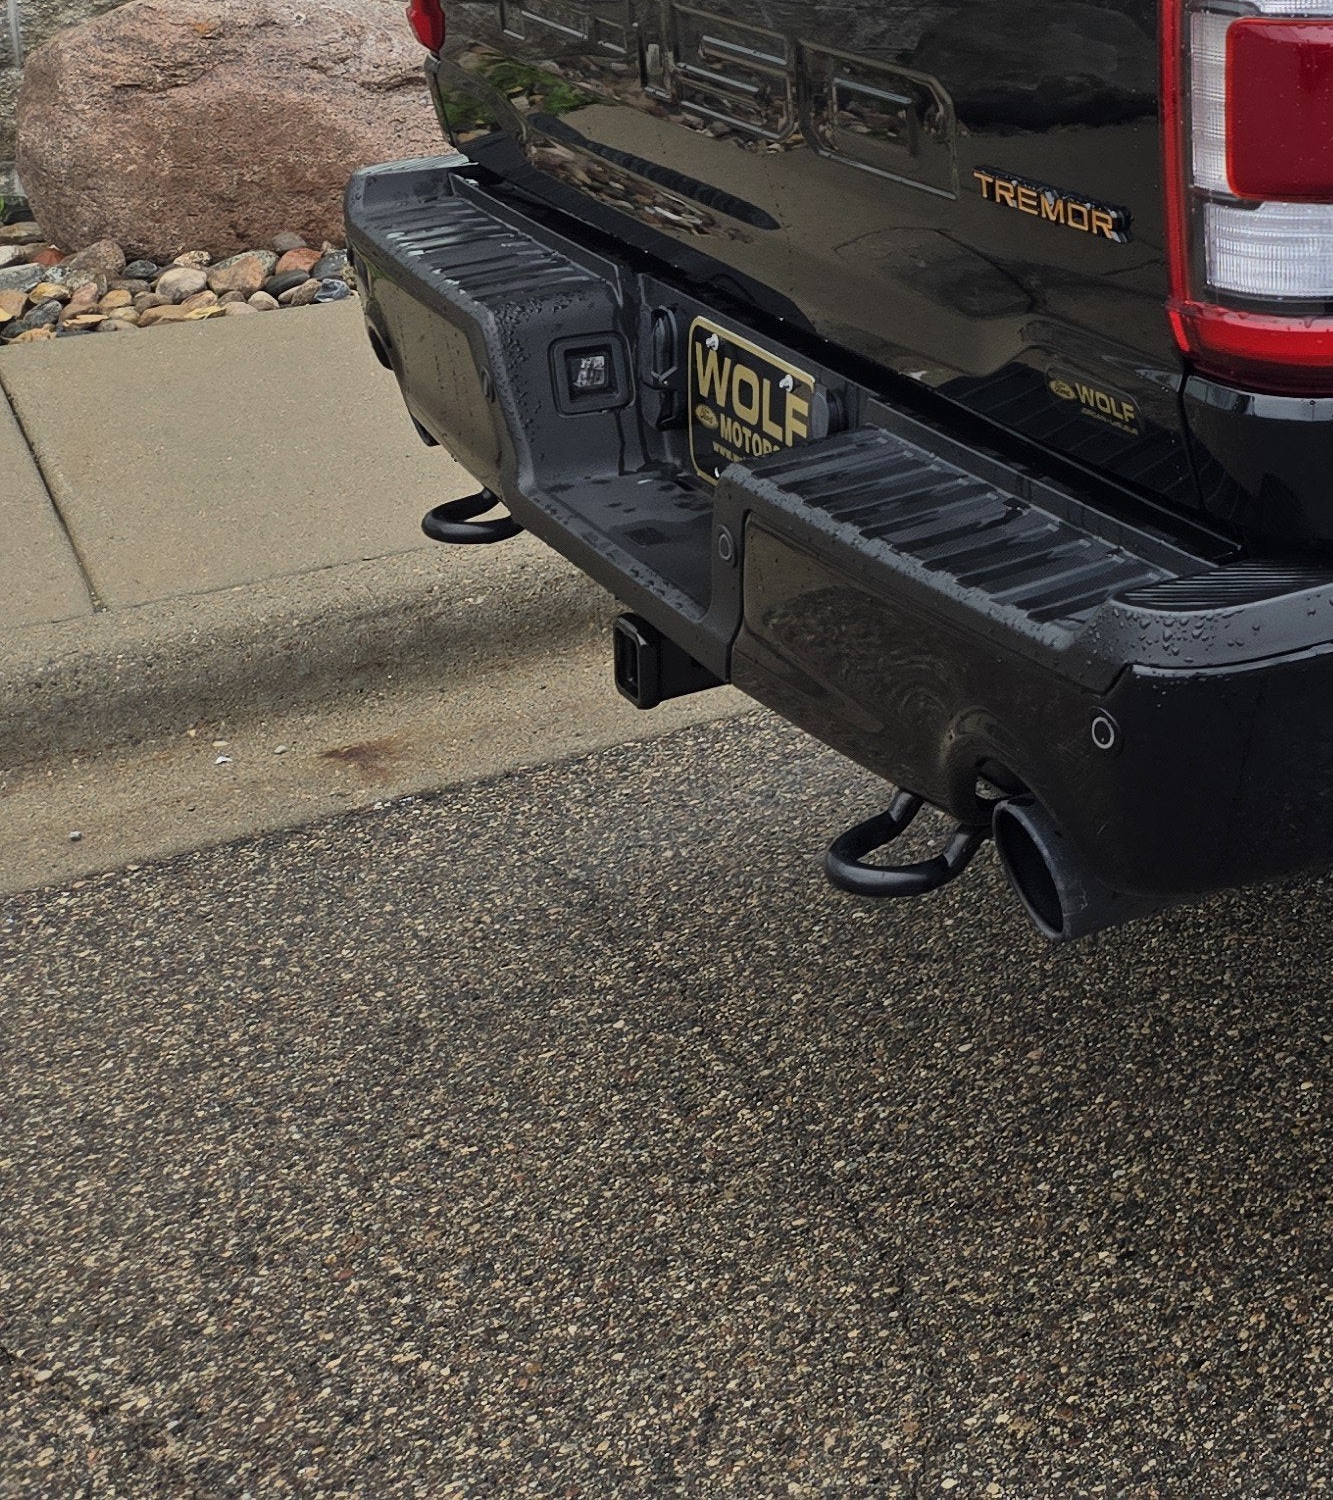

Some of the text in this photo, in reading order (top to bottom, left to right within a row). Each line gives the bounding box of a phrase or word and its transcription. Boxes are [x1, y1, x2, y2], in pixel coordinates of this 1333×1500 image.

[972, 169, 1115, 241] TREMOR
[695, 341, 809, 447] WOLF
[1075, 382, 1135, 422] WOLF
